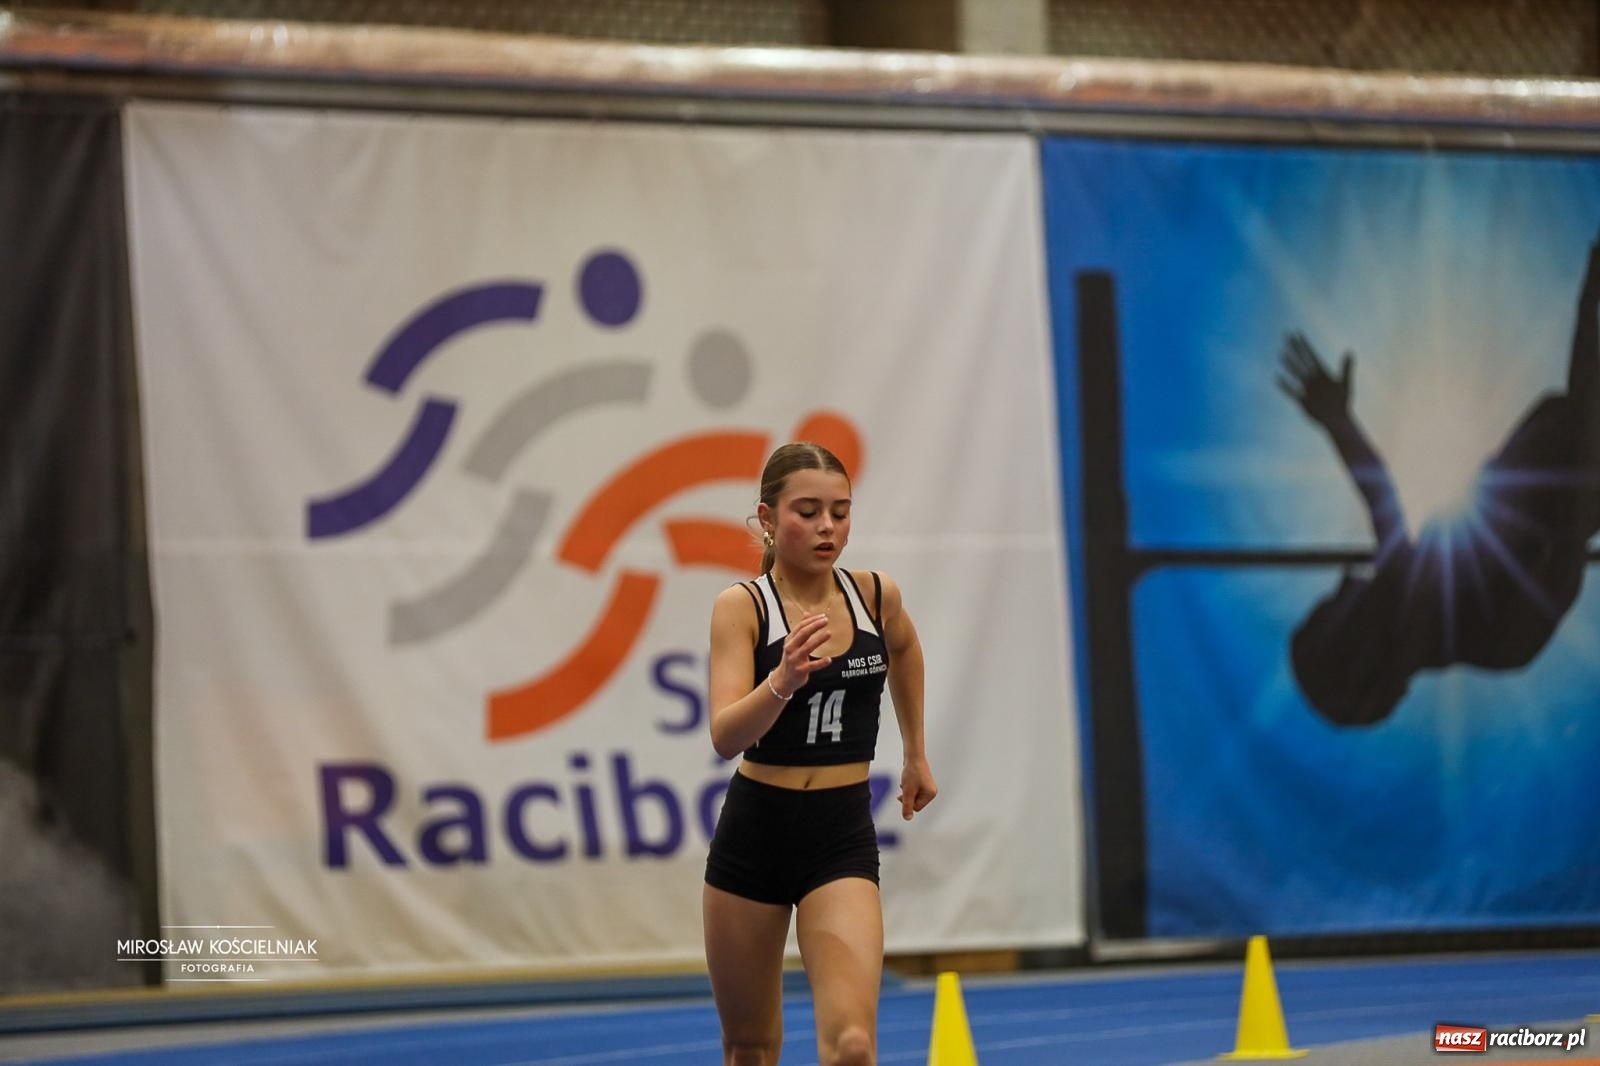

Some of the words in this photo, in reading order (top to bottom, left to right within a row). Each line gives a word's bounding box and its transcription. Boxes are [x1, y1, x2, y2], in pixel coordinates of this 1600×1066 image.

[847, 657, 866, 669] MOS
[651, 653, 706, 736] S
[806, 689, 846, 744] 14
